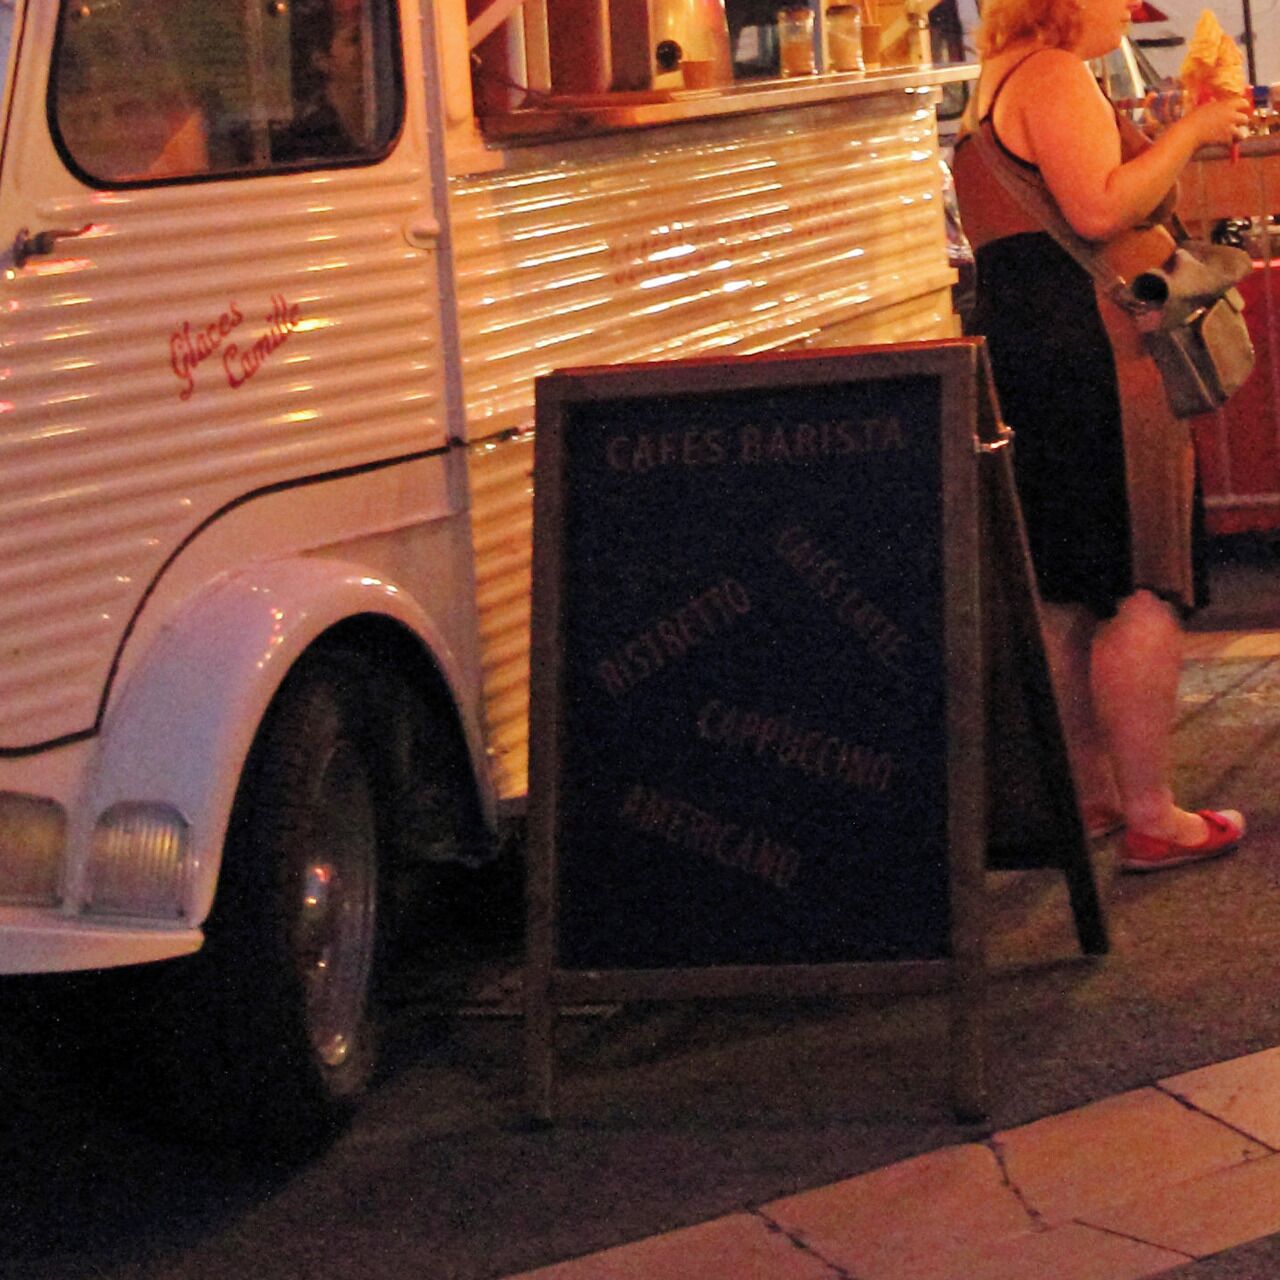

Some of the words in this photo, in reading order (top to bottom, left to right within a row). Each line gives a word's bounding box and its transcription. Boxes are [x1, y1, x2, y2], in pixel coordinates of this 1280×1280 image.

[170, 301, 243, 400] Glaces
[741, 417, 906, 465] BARISTA
[597, 577, 752, 695] RISTRETTO
[620, 783, 802, 889] AMERICANO
